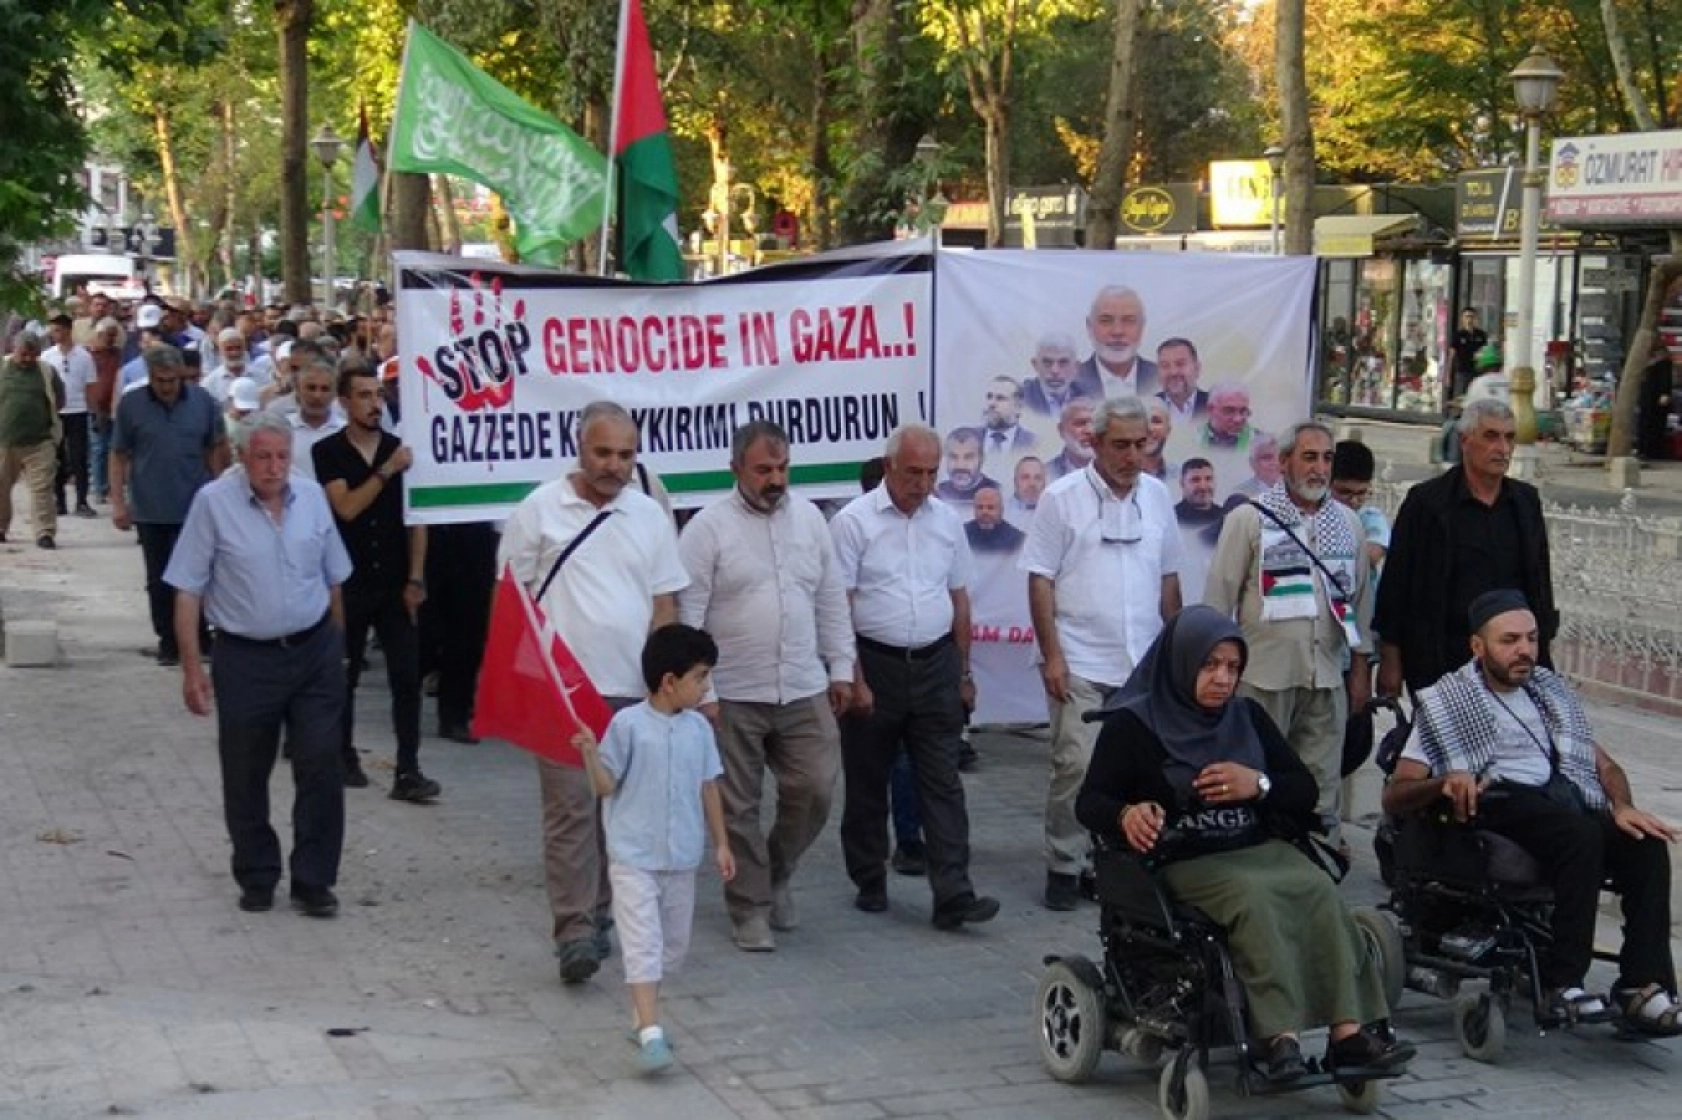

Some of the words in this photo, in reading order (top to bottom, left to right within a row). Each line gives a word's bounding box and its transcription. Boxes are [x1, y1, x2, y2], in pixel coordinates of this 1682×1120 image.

[435, 321, 532, 400] STOP
[543, 314, 728, 375] GENOCIDE
[739, 311, 780, 367] IN
[431, 411, 553, 464] GAZZEDE
